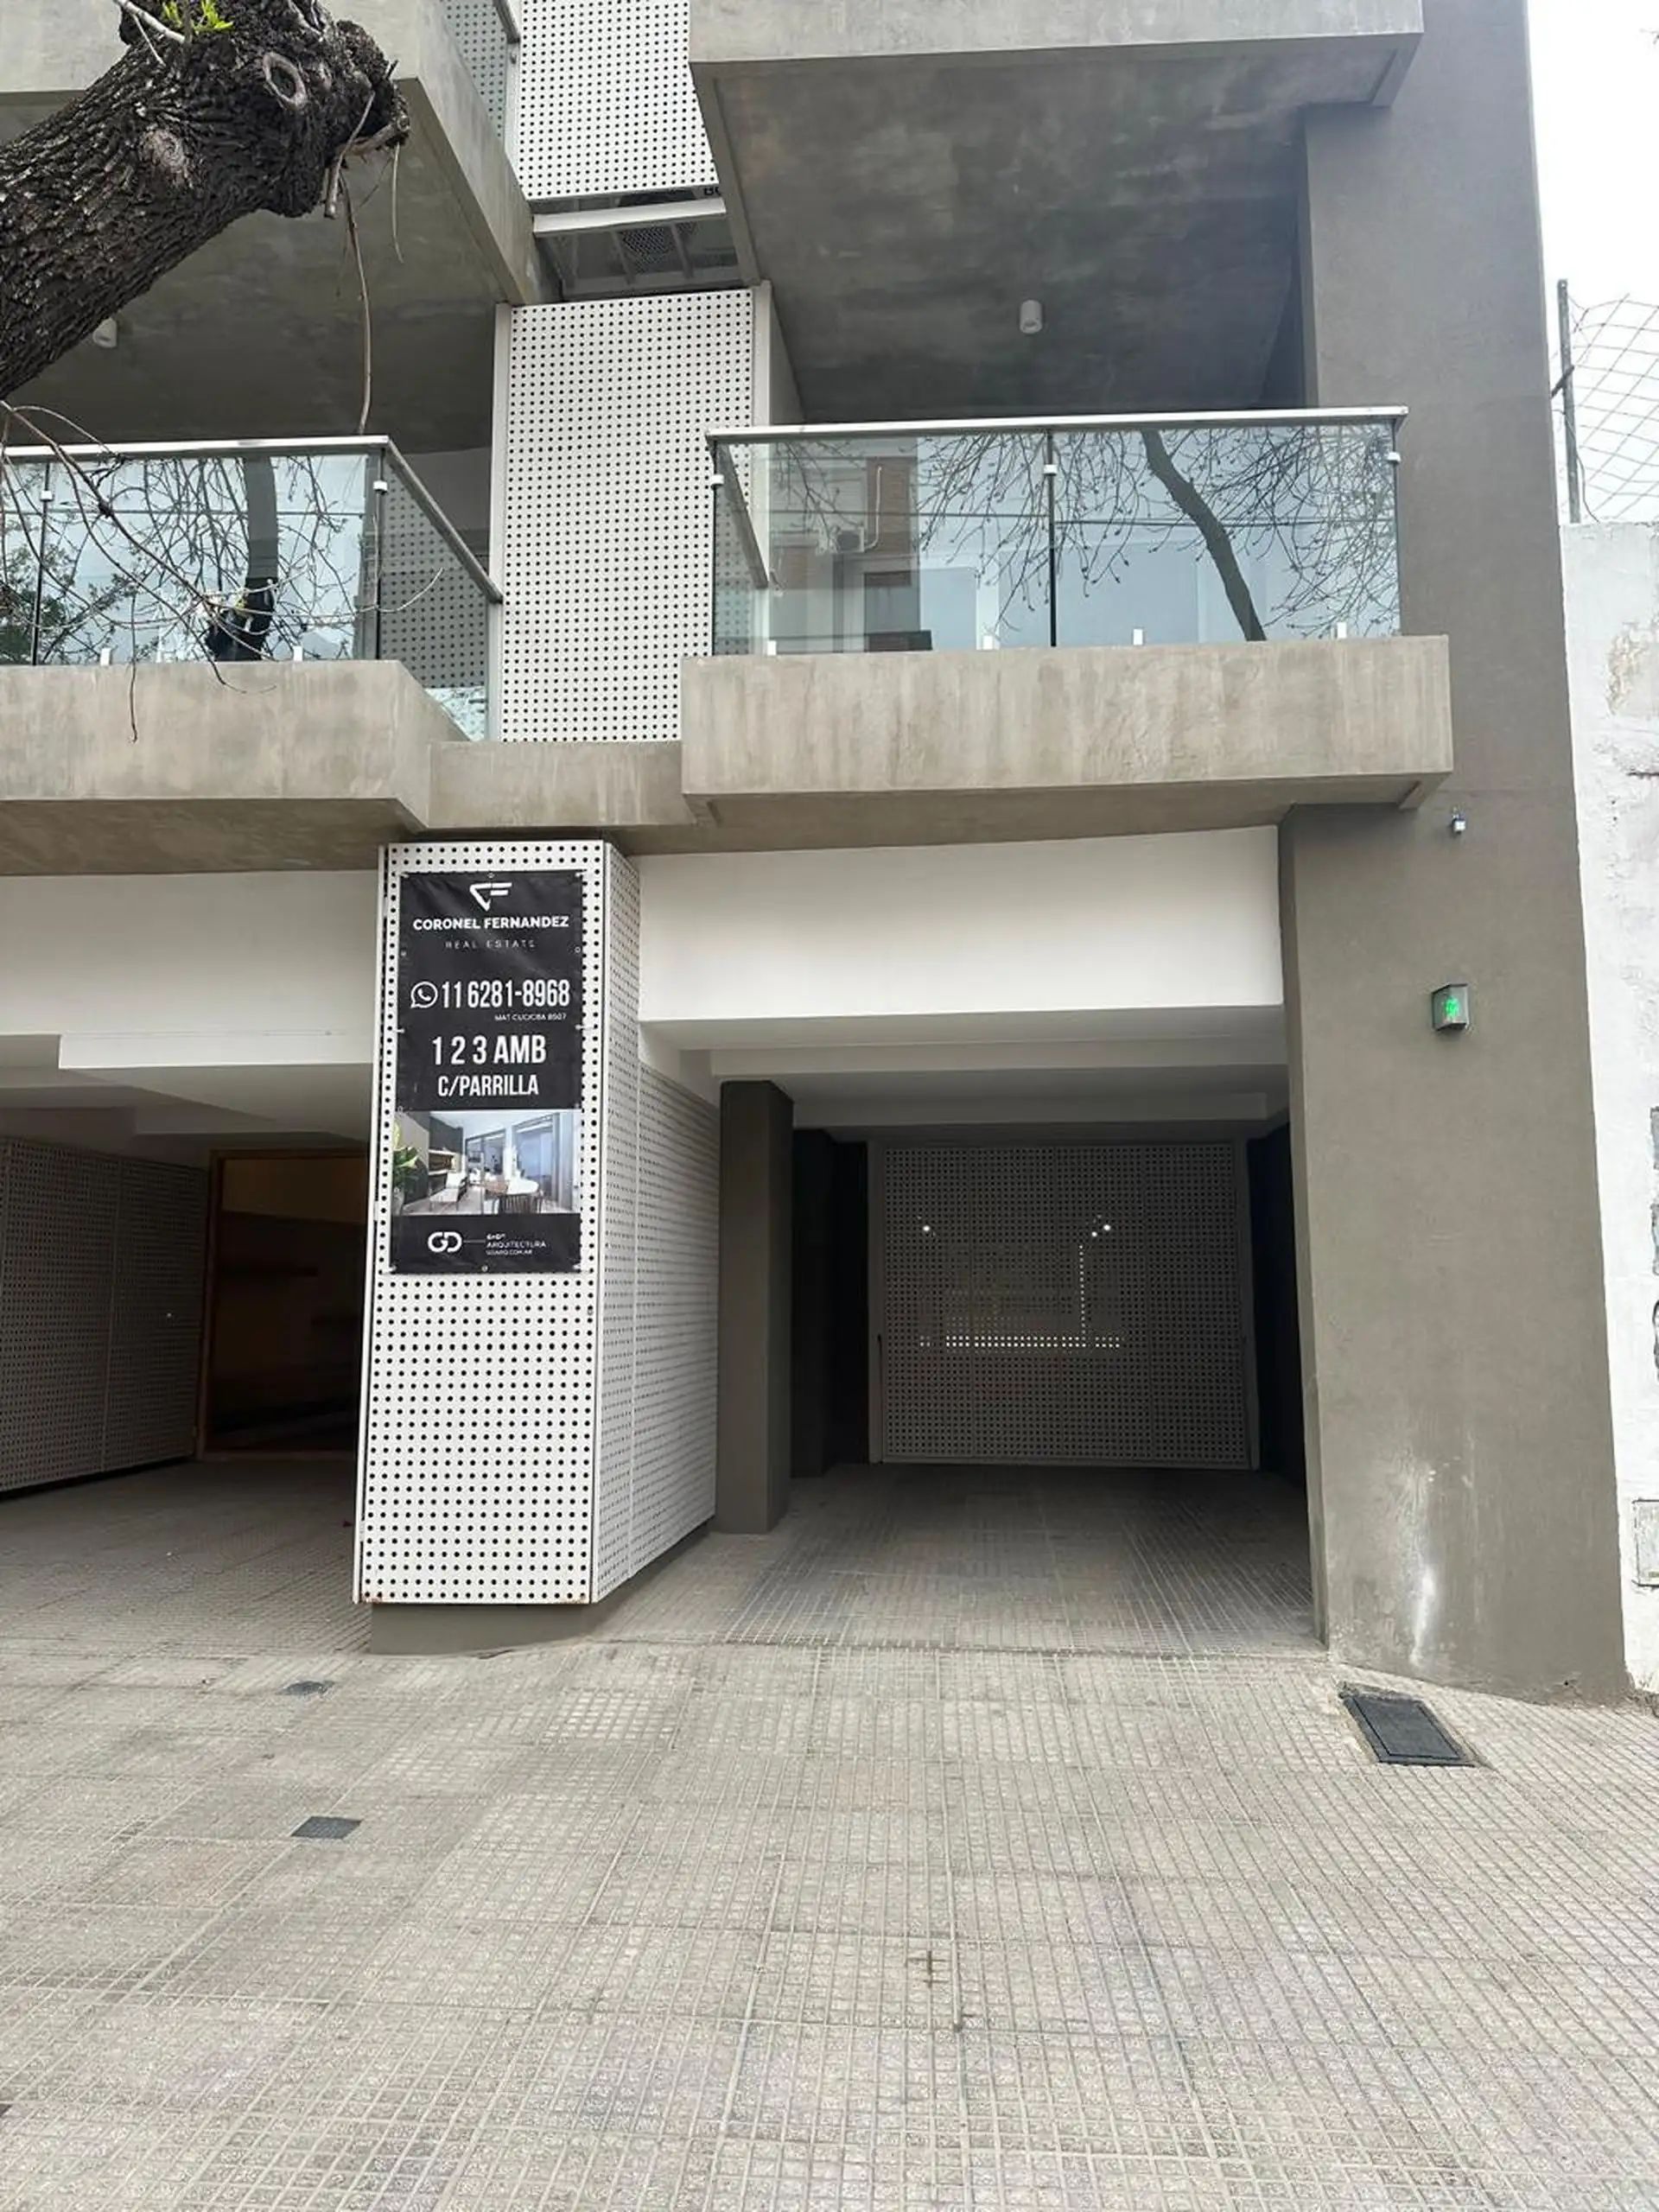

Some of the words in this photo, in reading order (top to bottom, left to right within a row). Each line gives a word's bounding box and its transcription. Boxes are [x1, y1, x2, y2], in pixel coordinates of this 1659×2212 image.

[412, 918, 481, 931] CORONEL
[484, 915, 569, 930] FERNANDEZ
[444, 939, 478, 950] REAL
[486, 938, 536, 949] ESTATE
[467, 979, 570, 1008] 6281-8968
[432, 1036, 442, 1065] 1
[450, 1035, 466, 1065] 2
[473, 1035, 487, 1065] 3
[493, 1034, 547, 1065] AMB
[438, 1074, 539, 1097] C/PARRILLA
